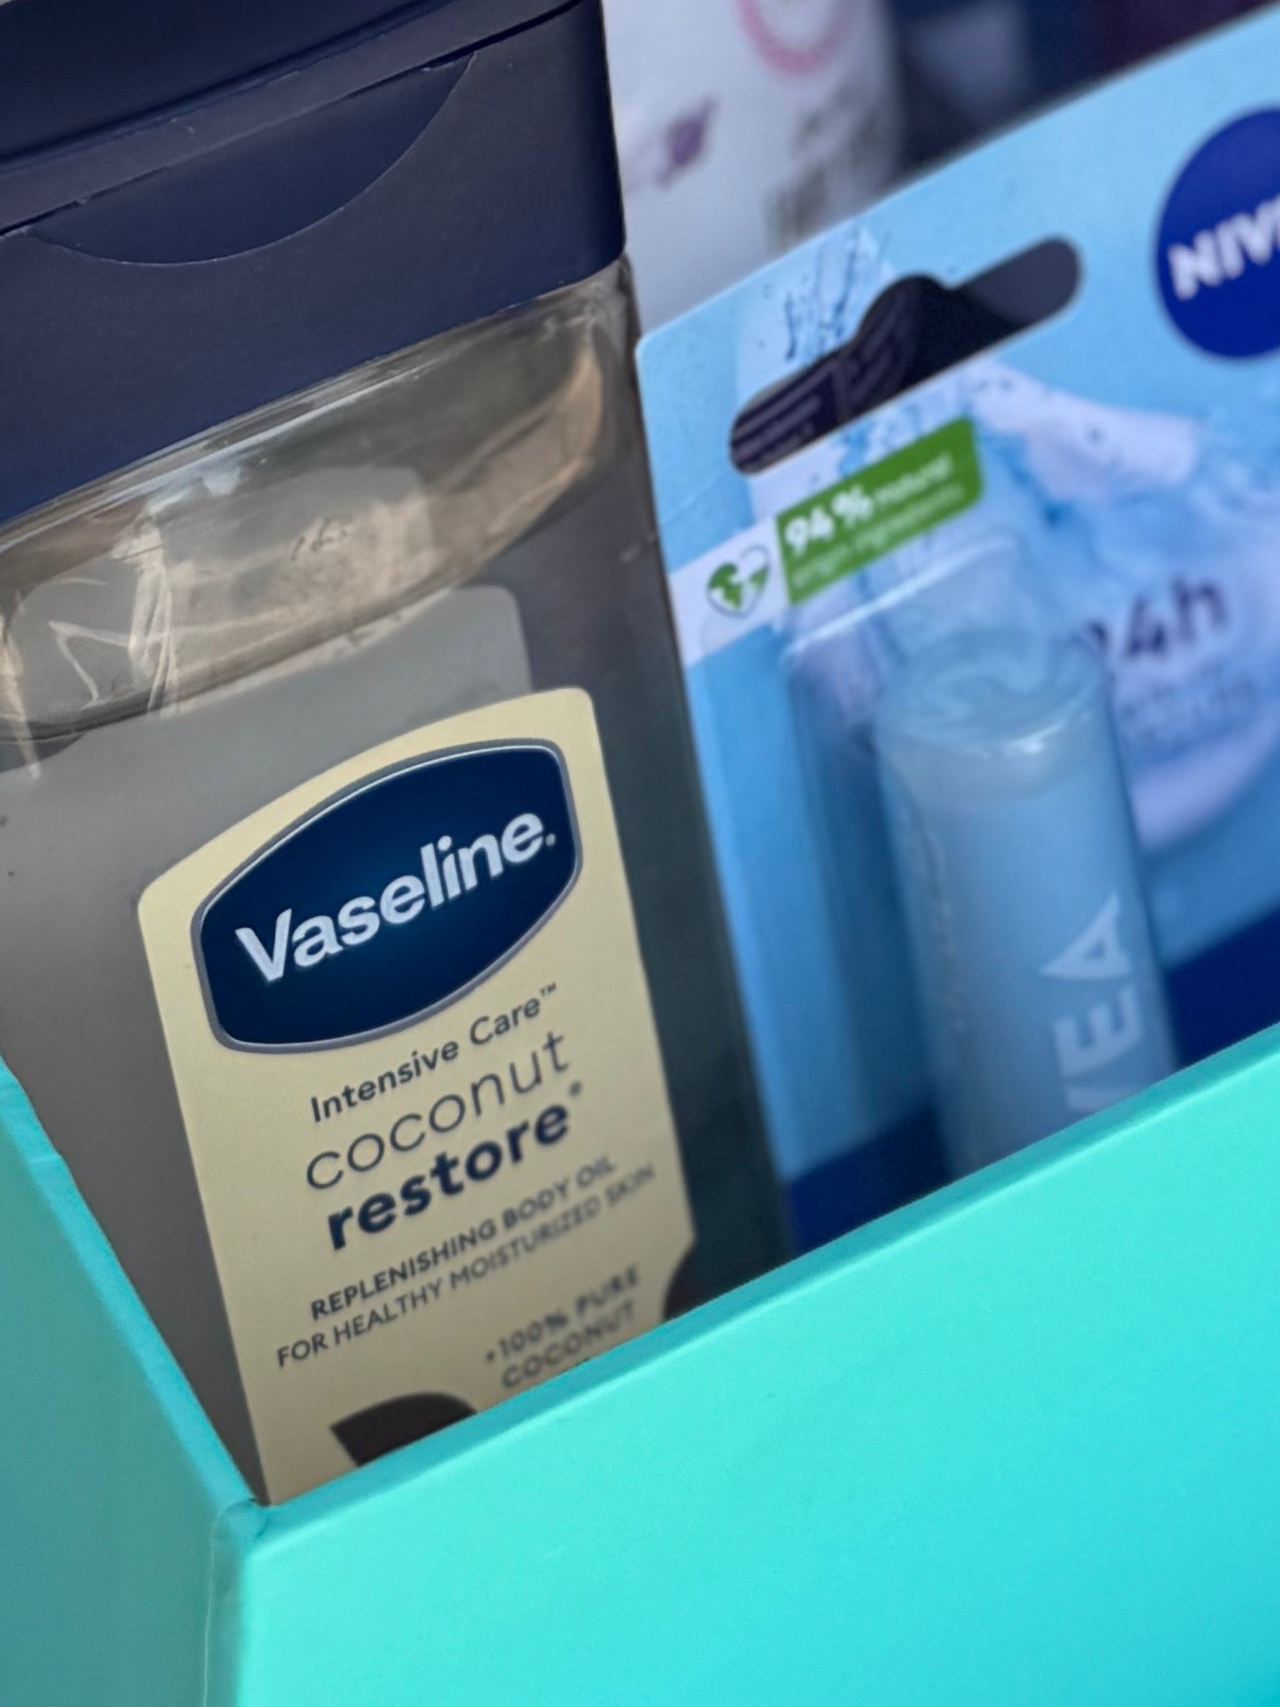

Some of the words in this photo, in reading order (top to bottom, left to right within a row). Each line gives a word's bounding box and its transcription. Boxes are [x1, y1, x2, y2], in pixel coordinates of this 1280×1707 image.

[306, 1031, 570, 1191] coconut
[310, 1040, 459, 1123] Intensive
[276, 1332, 329, 1369] FOR
[332, 1278, 442, 1346] HEALTHY
[449, 1196, 602, 1292] MOISTURIZED
[606, 1165, 657, 1209] SKIN
[311, 1218, 497, 1320] REPLENISHING
[501, 1179, 570, 1230] BODY
[575, 1155, 616, 1188] OIL
[575, 1264, 638, 1317] PURE
[501, 1298, 634, 1388] COCONUT
